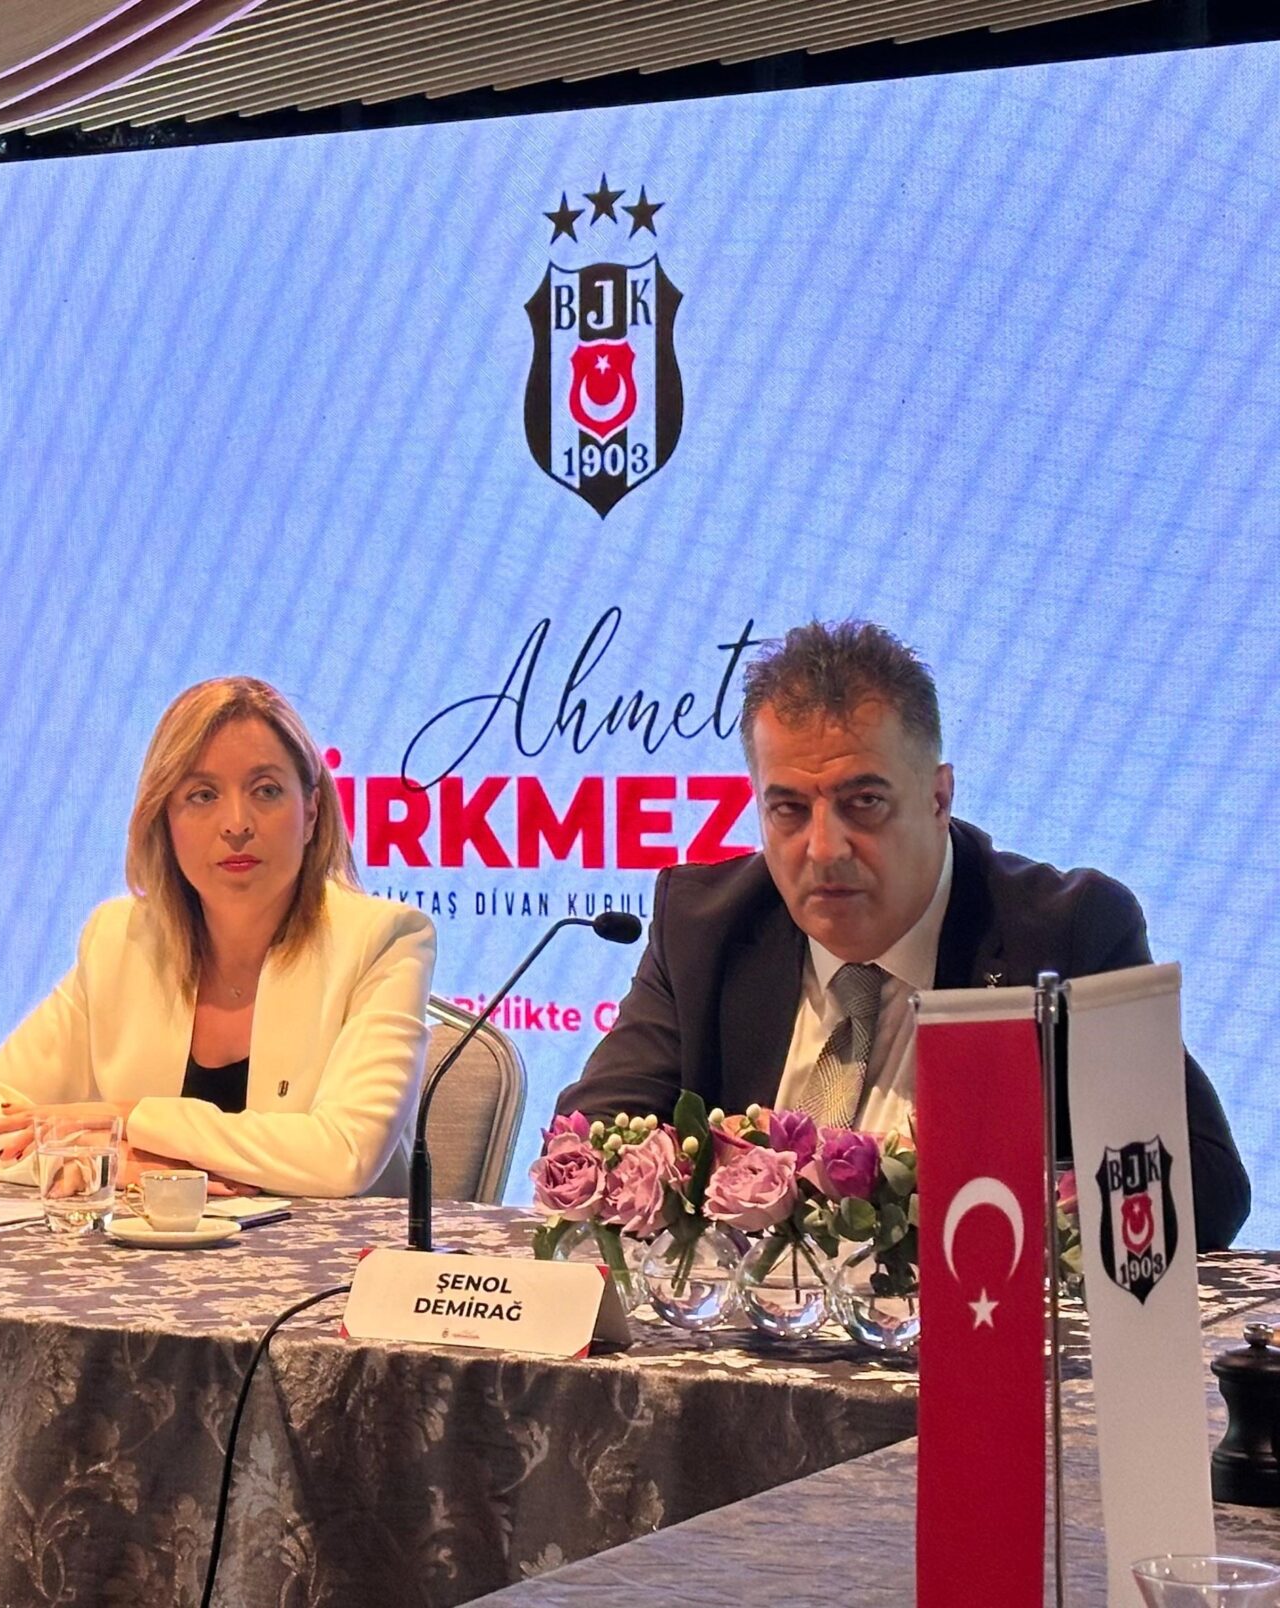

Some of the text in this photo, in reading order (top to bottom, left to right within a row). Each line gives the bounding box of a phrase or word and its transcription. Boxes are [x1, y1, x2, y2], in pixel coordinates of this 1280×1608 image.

[554, 278, 653, 331] BJK
[562, 443, 649, 477] 1903
[401, 606, 770, 793] Ahmet
[475, 888, 549, 917] DİVAN
[568, 892, 648, 918] KURUL
[1108, 1151, 1161, 1191] BJK
[436, 1273, 512, 1294] ŞENOL
[1119, 1252, 1165, 1285] 1903
[413, 1295, 523, 1322] DEMİRAĞ
